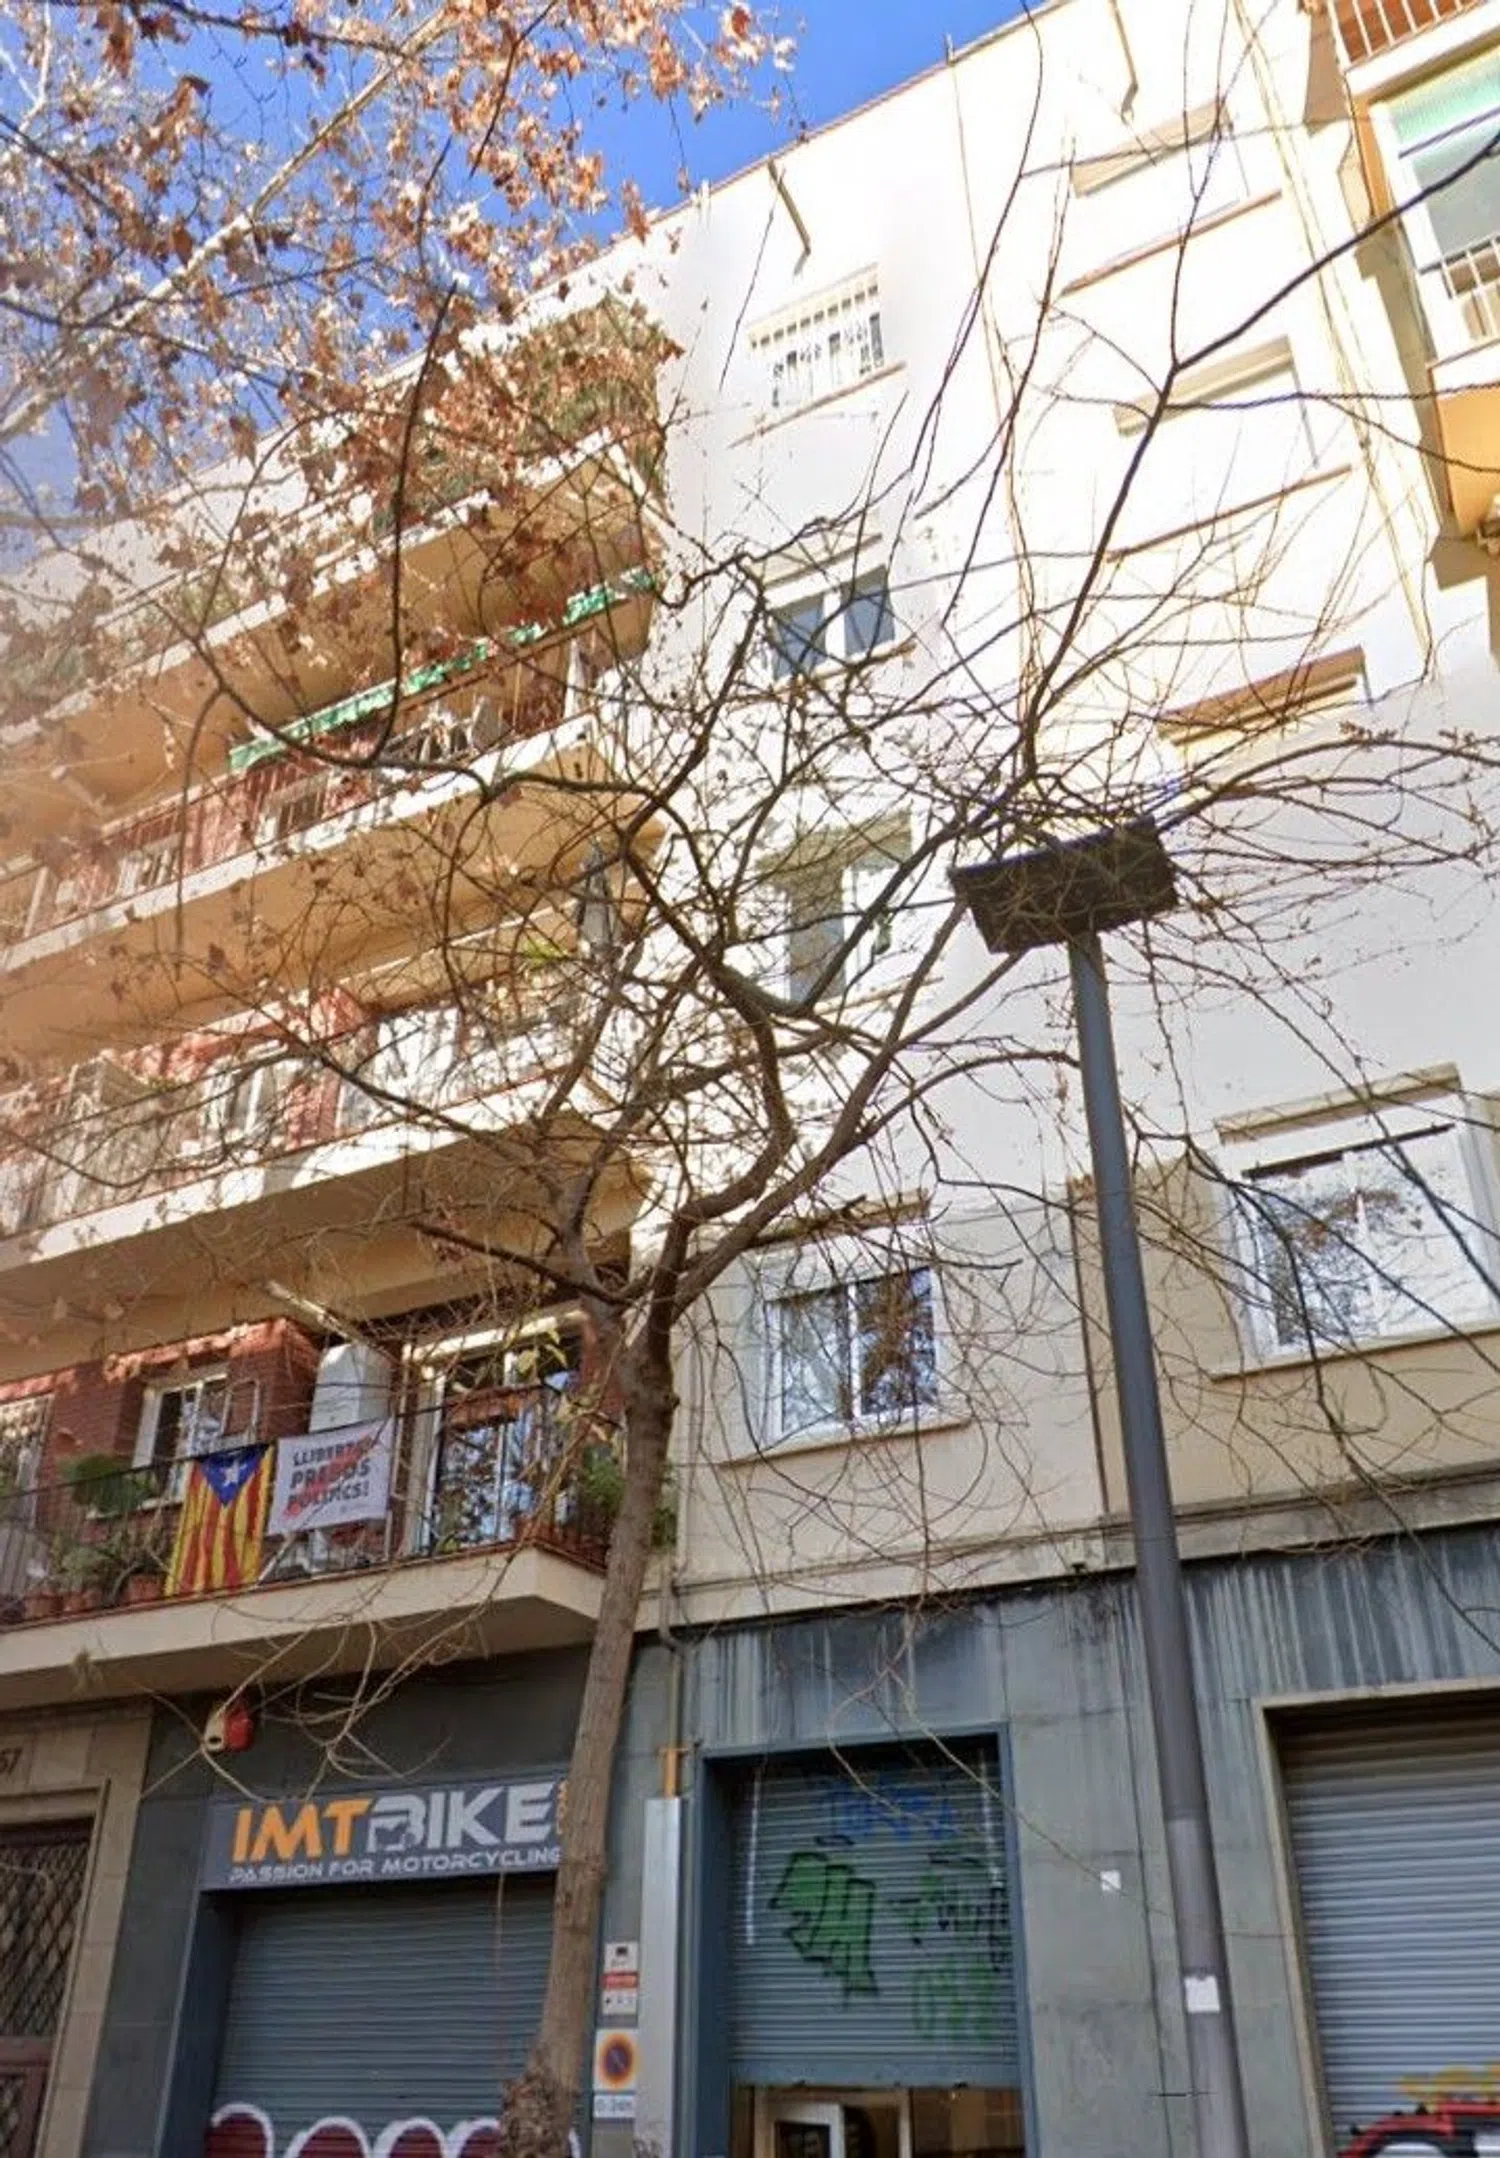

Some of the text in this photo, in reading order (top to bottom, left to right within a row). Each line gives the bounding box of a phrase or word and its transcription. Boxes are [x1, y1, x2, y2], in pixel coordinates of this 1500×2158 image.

[292, 1436, 374, 1466] LLIBERT
[227, 1862, 325, 1885] PASSION
[328, 1858, 376, 1878] FOR
